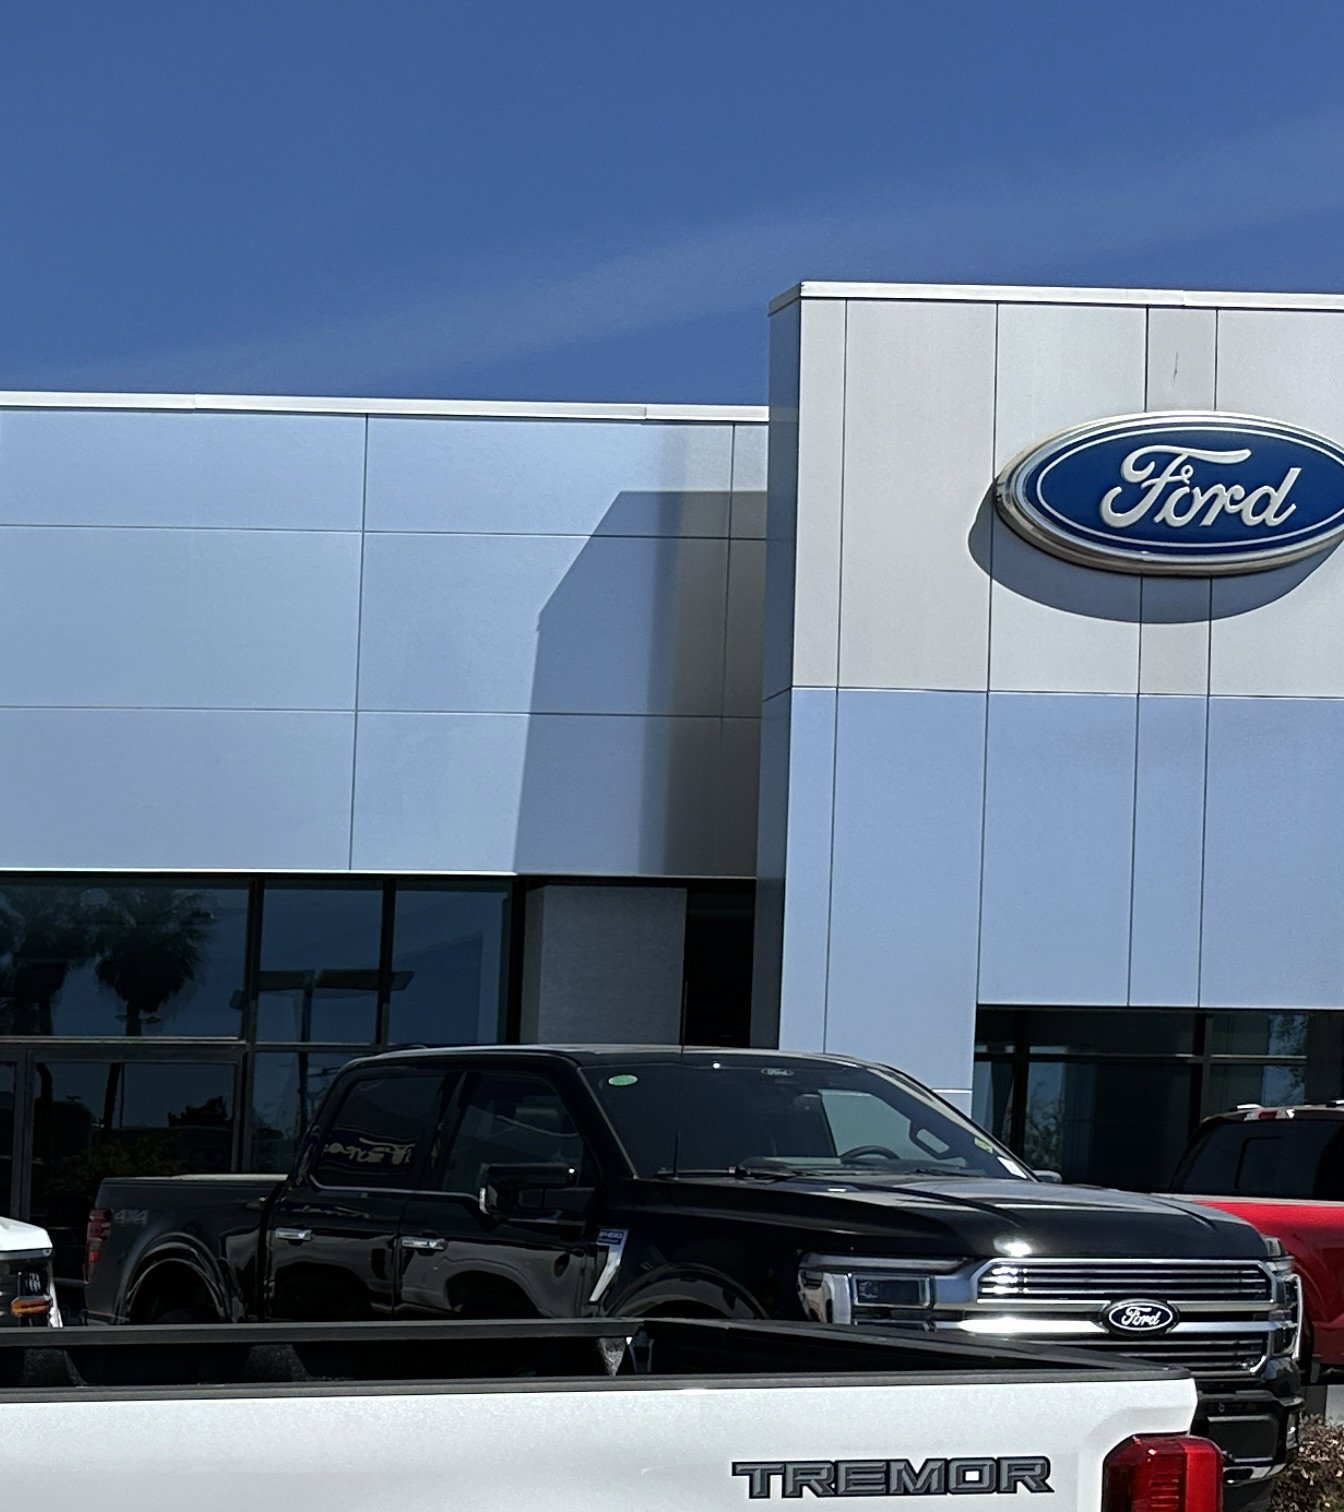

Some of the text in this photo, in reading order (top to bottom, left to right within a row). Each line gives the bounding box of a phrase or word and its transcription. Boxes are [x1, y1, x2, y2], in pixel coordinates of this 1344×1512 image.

[1100, 445, 1301, 528] Ford
[1121, 1306, 1162, 1326] Ford
[732, 1456, 1055, 1499] TREMOR
